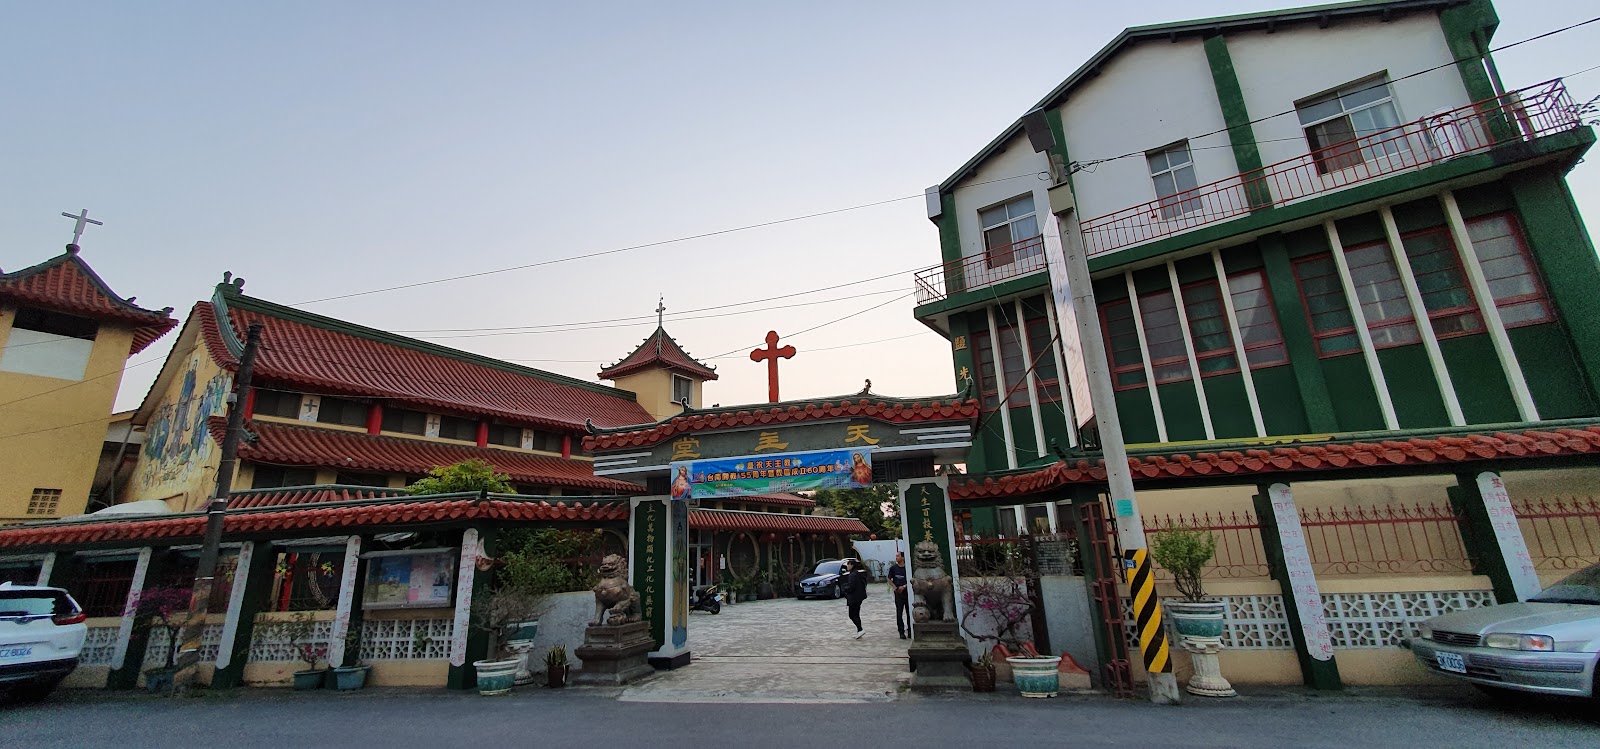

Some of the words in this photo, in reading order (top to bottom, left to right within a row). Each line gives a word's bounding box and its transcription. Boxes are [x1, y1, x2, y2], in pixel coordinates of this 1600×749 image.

[671, 424, 880, 461] 天主堂
[747, 458, 792, 470] 慶祝天主教
